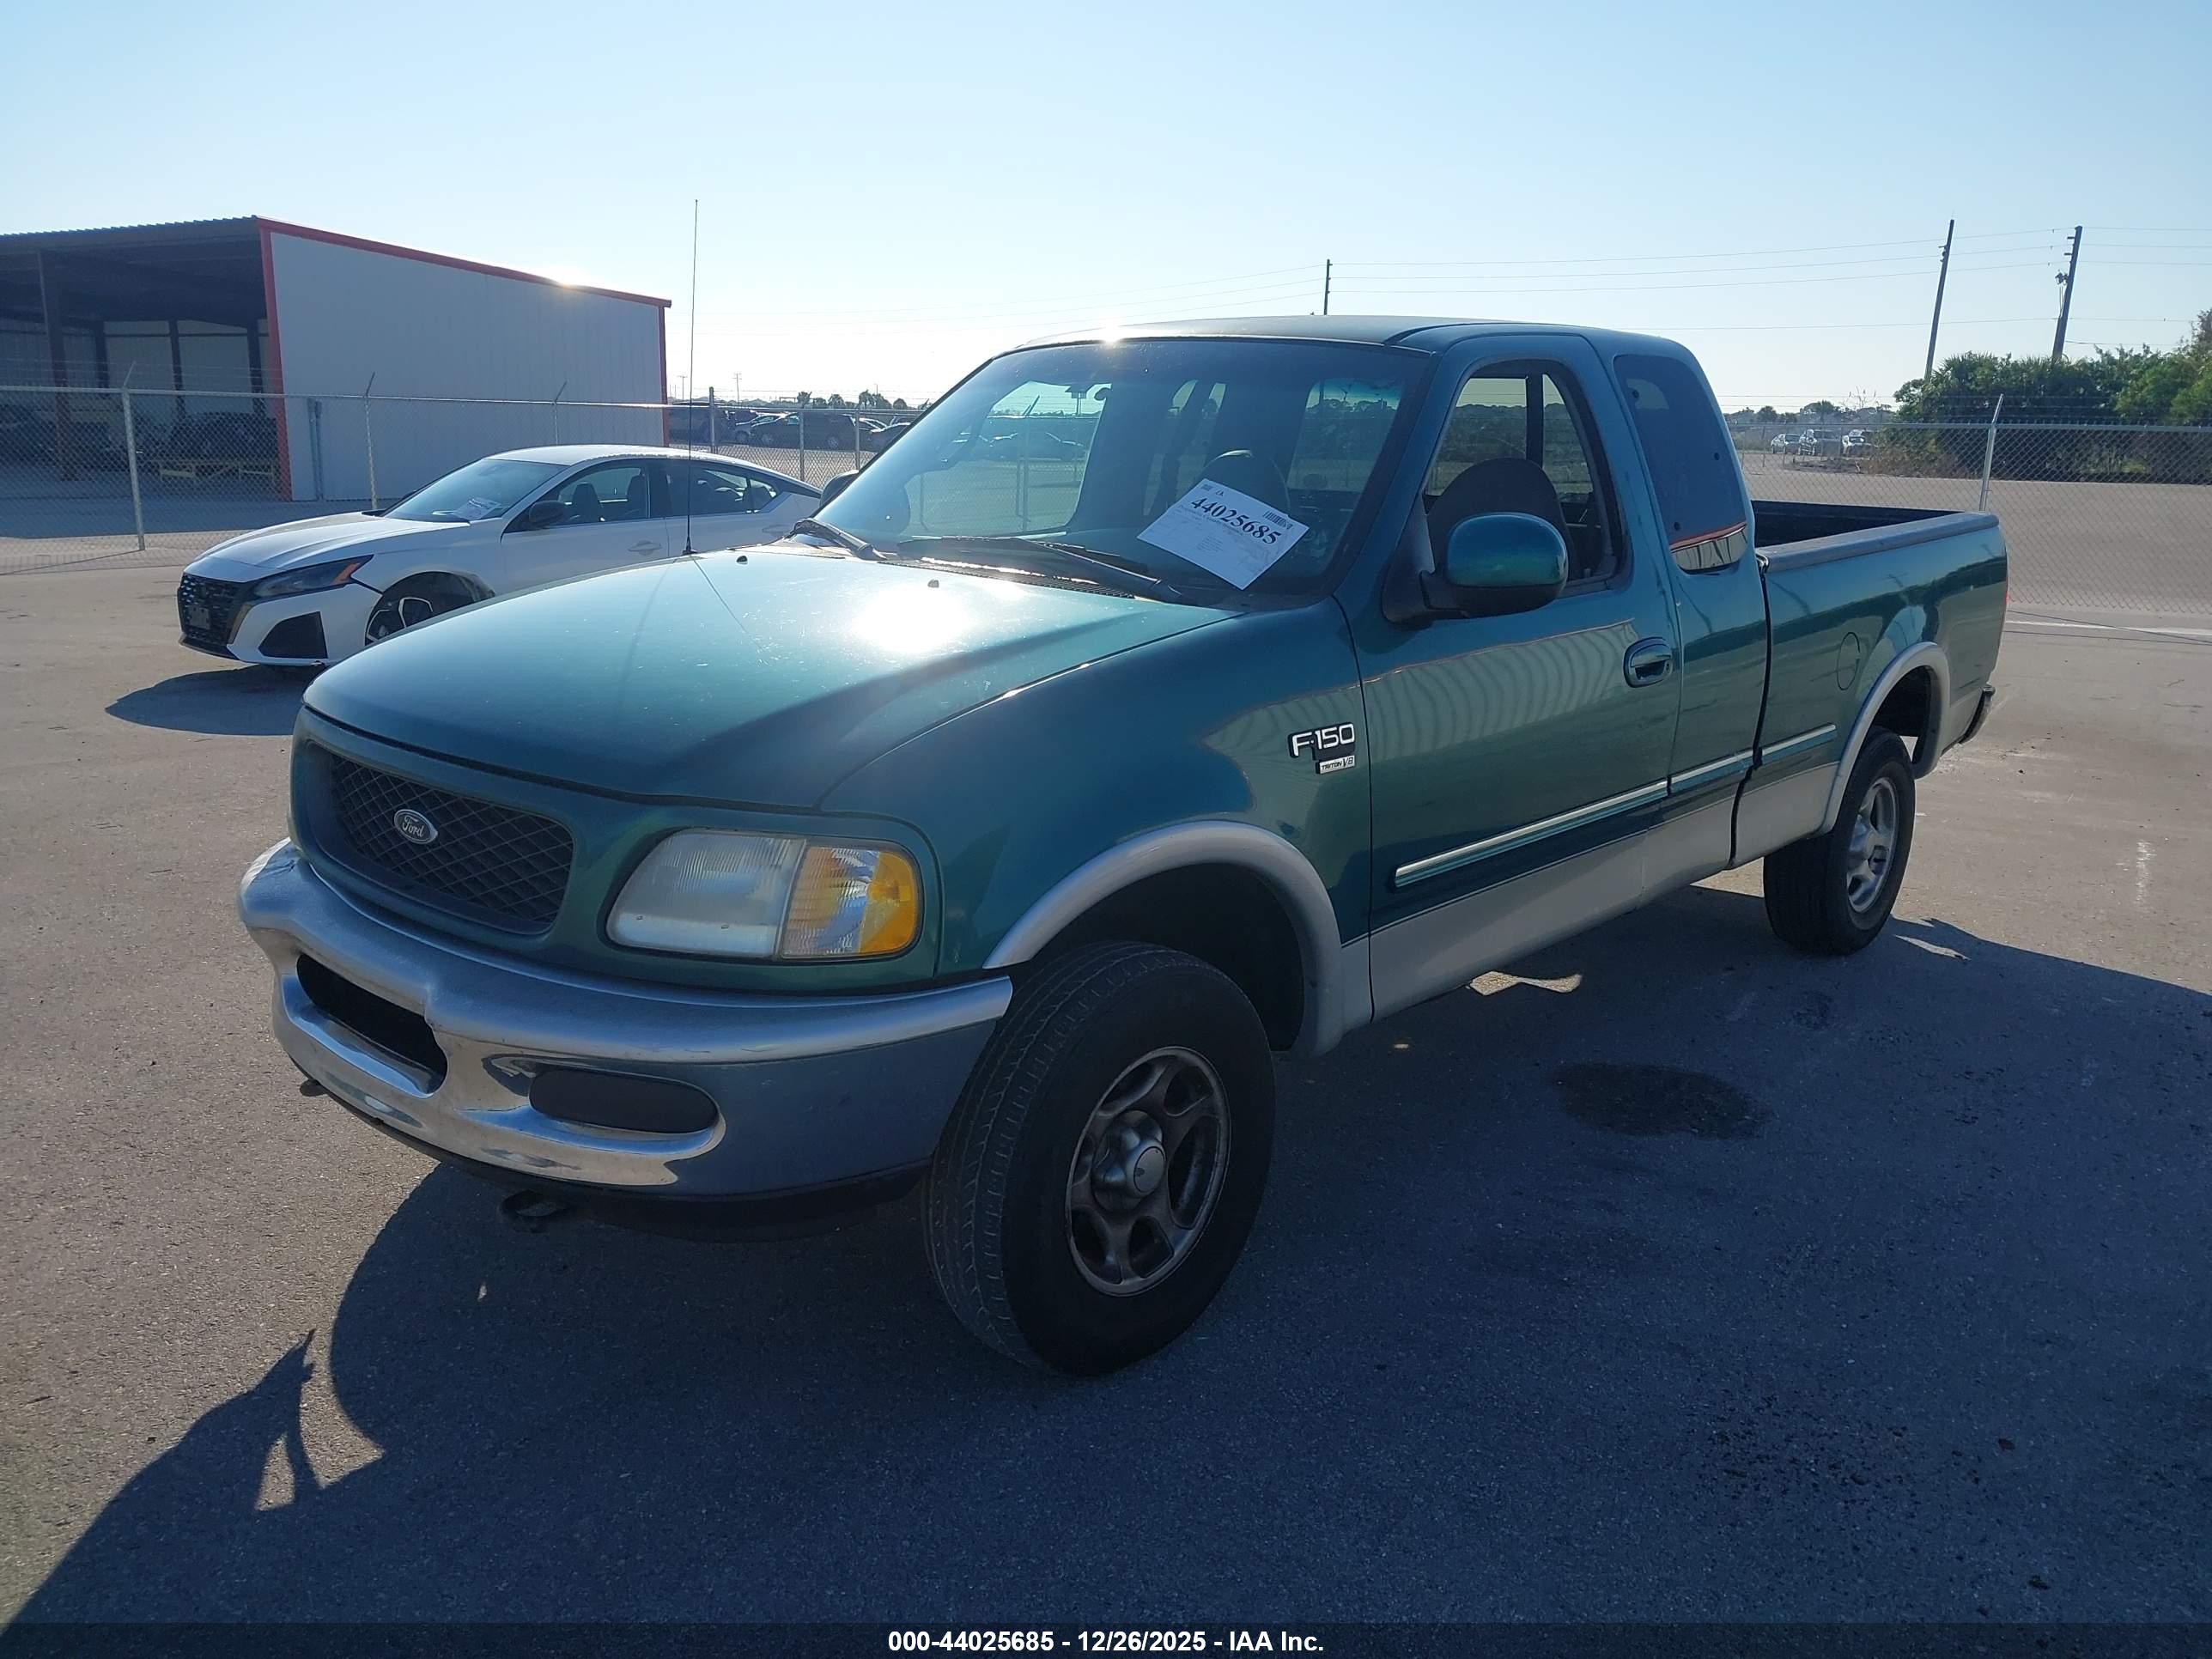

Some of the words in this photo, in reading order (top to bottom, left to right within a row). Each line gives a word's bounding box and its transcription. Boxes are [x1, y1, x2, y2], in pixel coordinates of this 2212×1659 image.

[1190, 497, 1282, 544] 44025685
[1322, 760, 1342, 771] TRITON
[1342, 757, 1354, 768] V8
[402, 815, 425, 838] Ford
